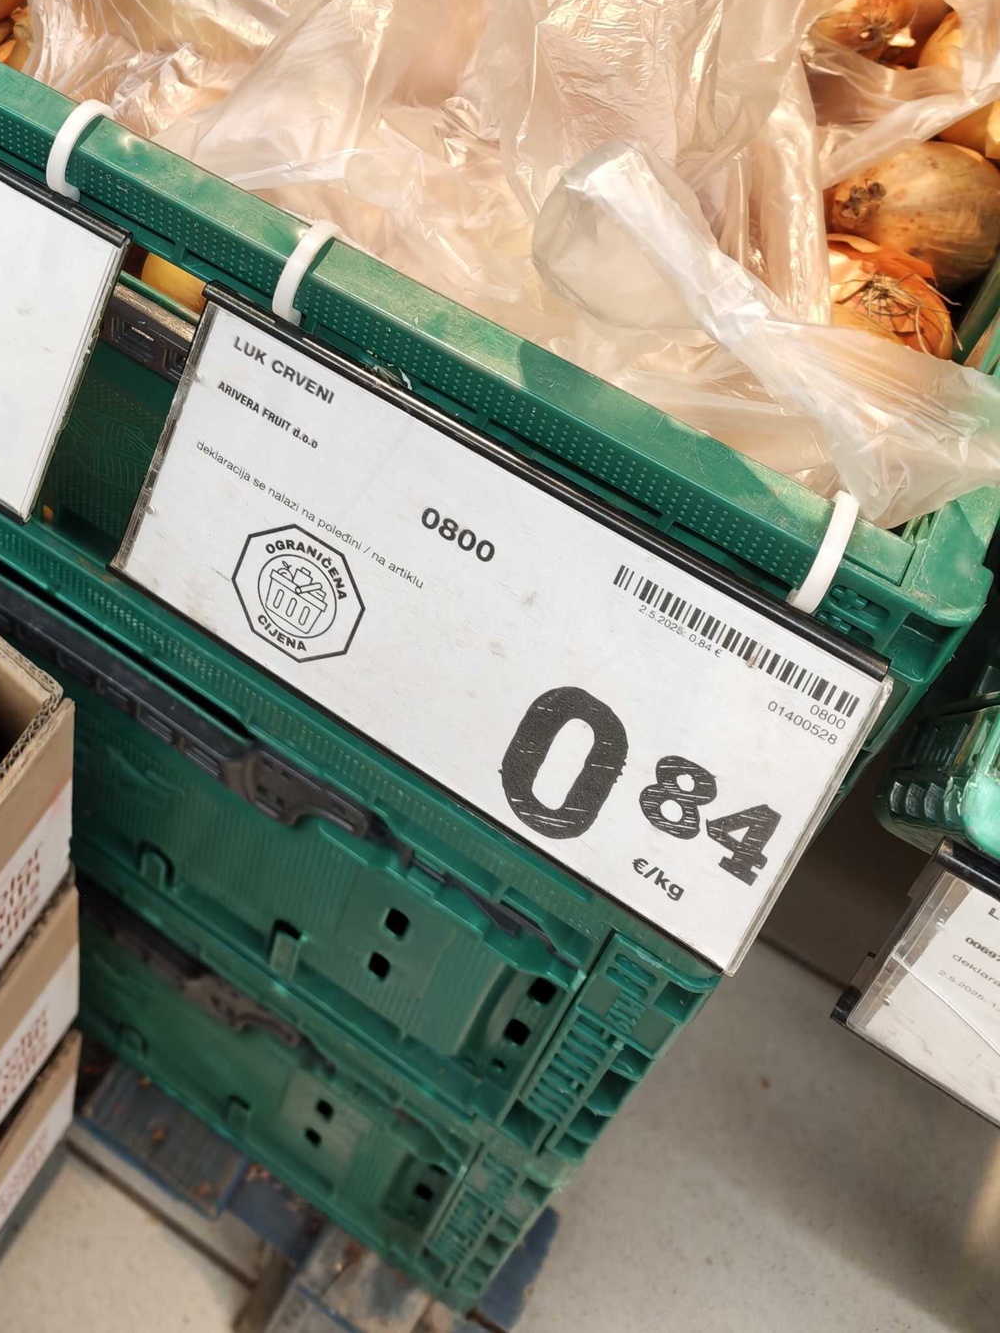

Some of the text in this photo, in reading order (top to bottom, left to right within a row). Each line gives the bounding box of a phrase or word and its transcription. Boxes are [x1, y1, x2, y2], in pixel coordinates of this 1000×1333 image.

[233, 335, 335, 405] LUK CRVENI
[217, 381, 319, 450] ARIVERA FRUIT d.o.o
[196, 440, 250, 483] deklaracija
[252, 477, 267, 491] se
[268, 486, 299, 512] nalazi
[301, 507, 316, 523] na
[317, 517, 363, 551] poleđini
[371, 551, 387, 567] na
[388, 560, 424, 589] artiklu
[421, 507, 495, 562] 0800
[265, 539, 347, 600] OGRANIČENA
[257, 614, 308, 652] CIJENA
[688, 633, 712, 652] 0,84
[714, 647, 724, 659] €
[767, 700, 838, 746] 01400528
[809, 704, 847, 731] 0800
[498, 686, 782, 886] 0 84
[632, 857, 685, 901] €/kg
